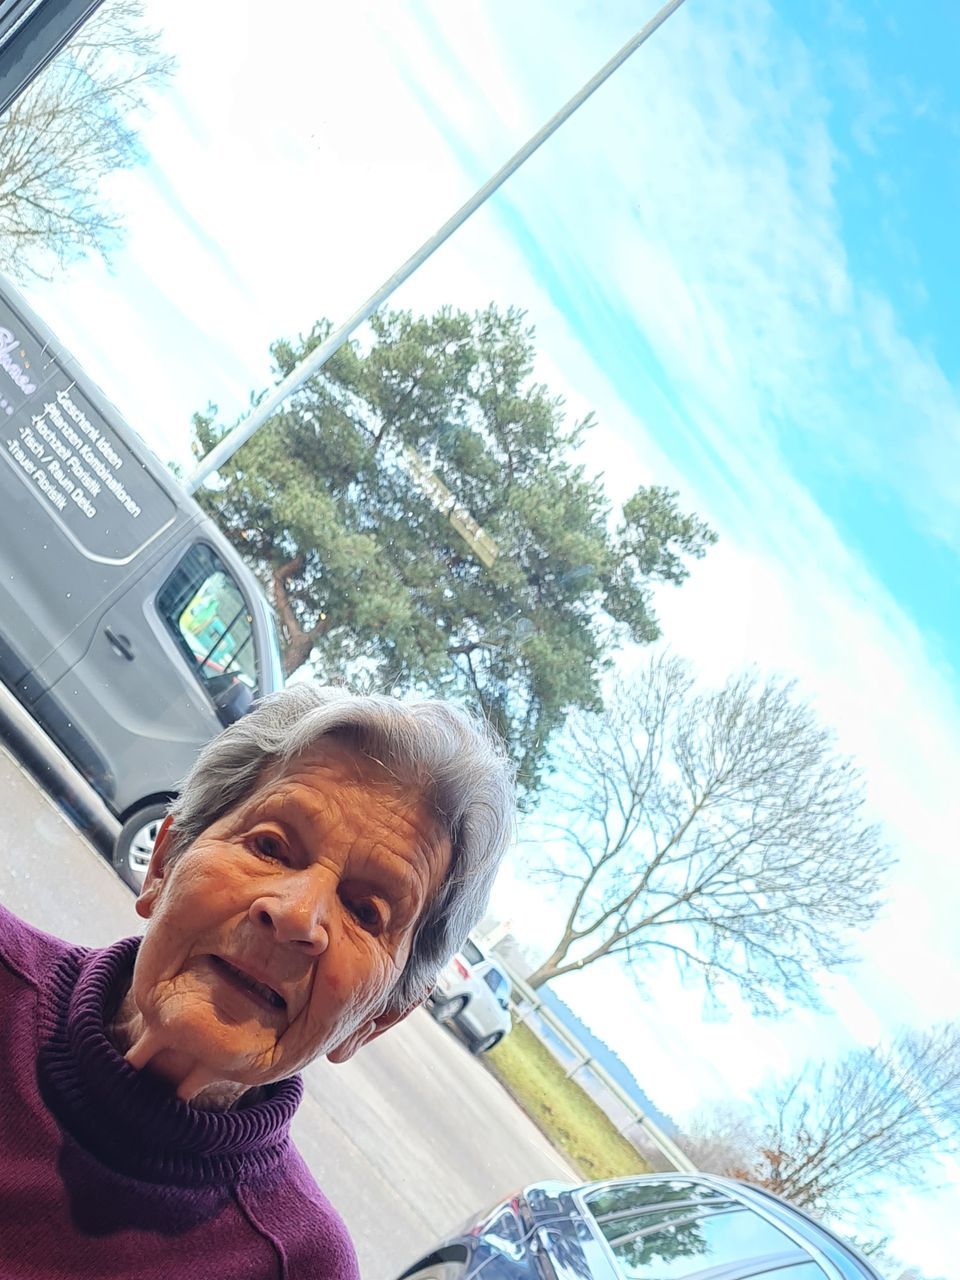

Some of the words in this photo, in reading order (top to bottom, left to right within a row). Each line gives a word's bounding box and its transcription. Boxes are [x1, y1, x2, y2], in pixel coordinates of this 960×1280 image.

[95, 436, 123, 470] Ideen
[32, 469, 67, 511] Floristik
[47, 460, 75, 493] Raum
[70, 487, 97, 518] Deko
[66, 455, 101, 498] Floristik
[79, 444, 141, 518] Kombinationen
